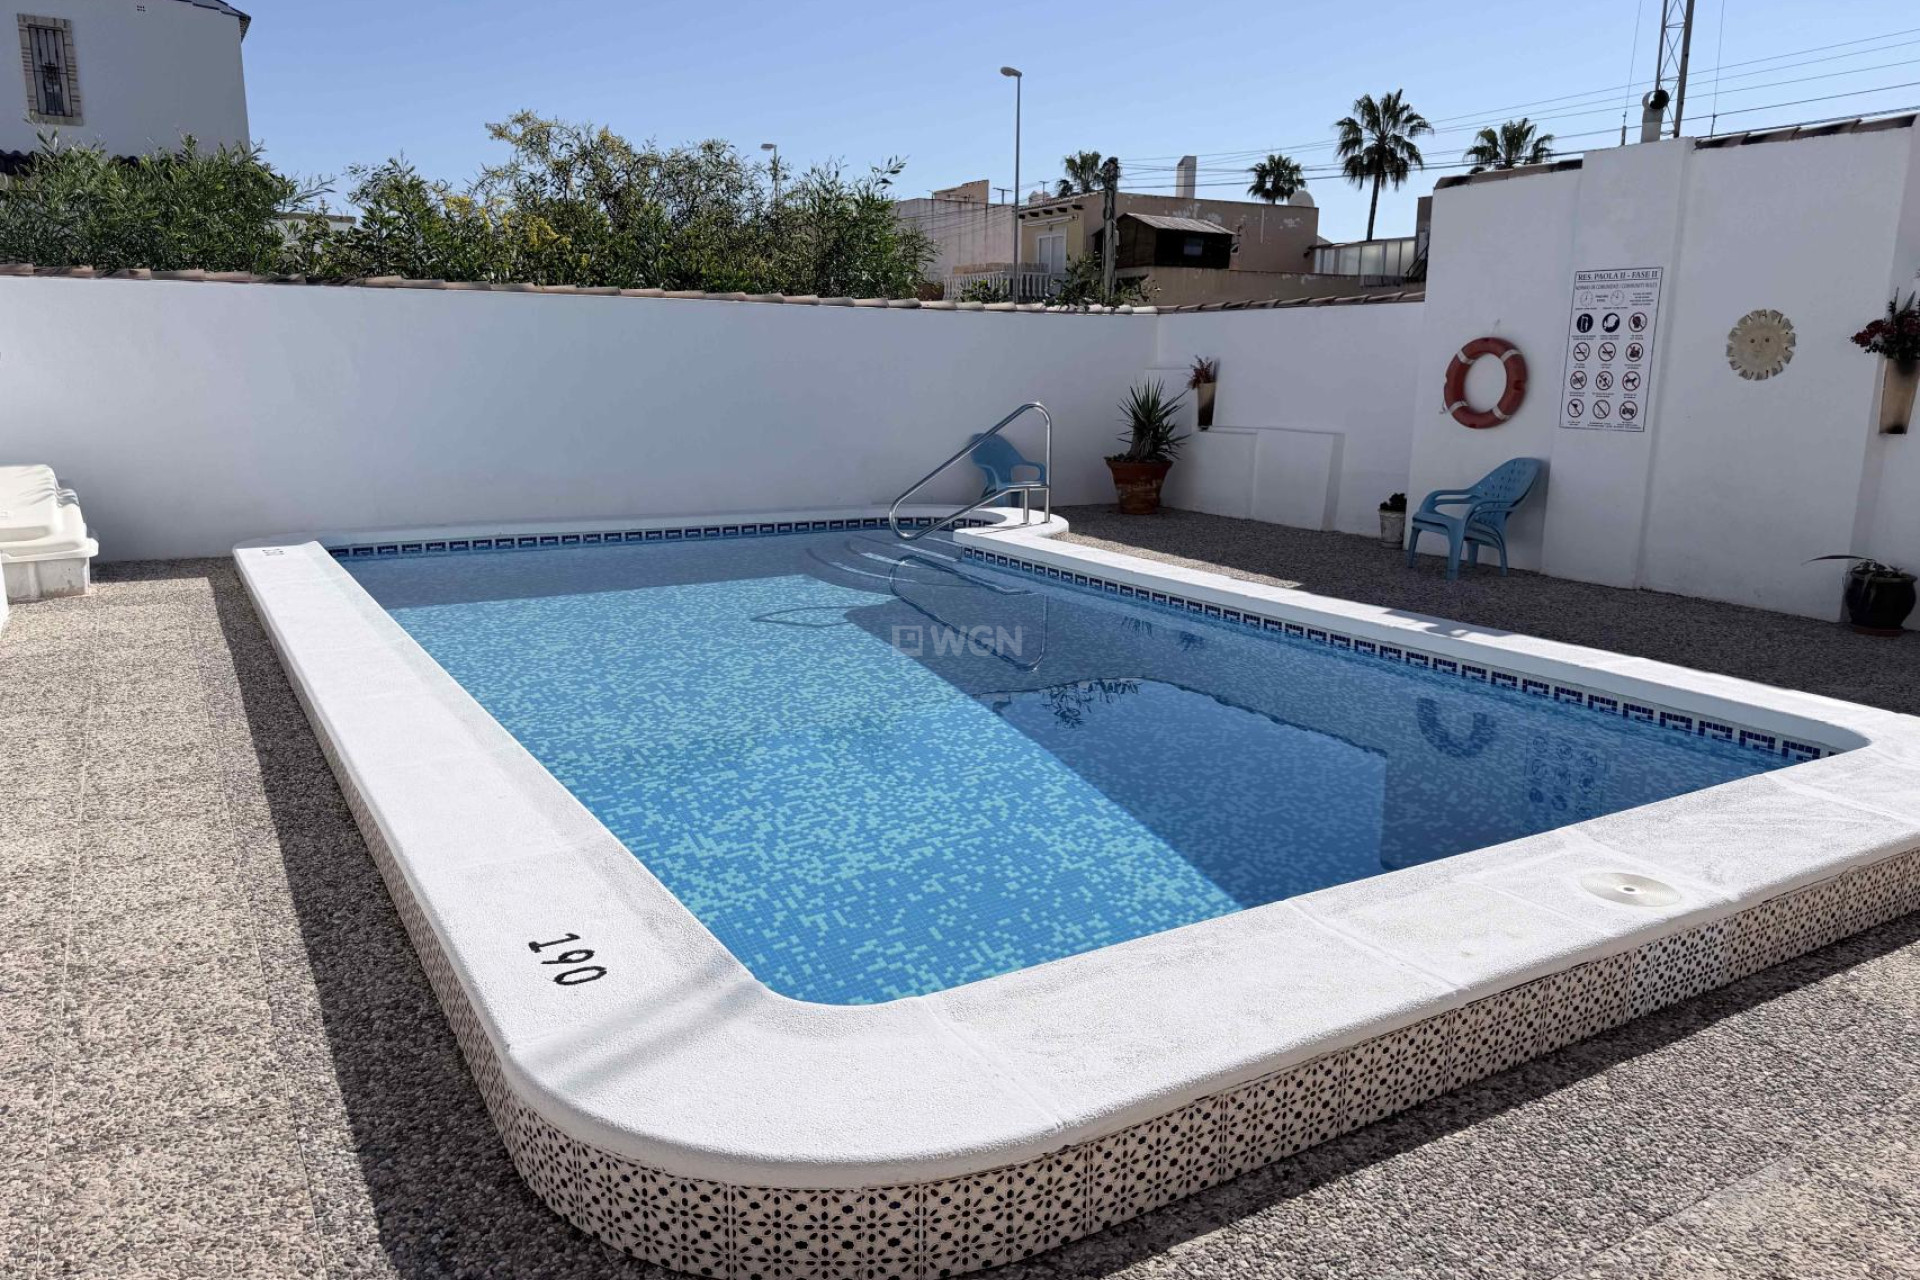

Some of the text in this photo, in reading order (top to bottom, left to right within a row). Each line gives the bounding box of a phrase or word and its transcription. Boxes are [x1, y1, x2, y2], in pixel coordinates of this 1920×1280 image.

[1594, 272, 1618, 280] PAOLA
[1631, 271, 1649, 279] FASE
[528, 932, 607, 986] 190
